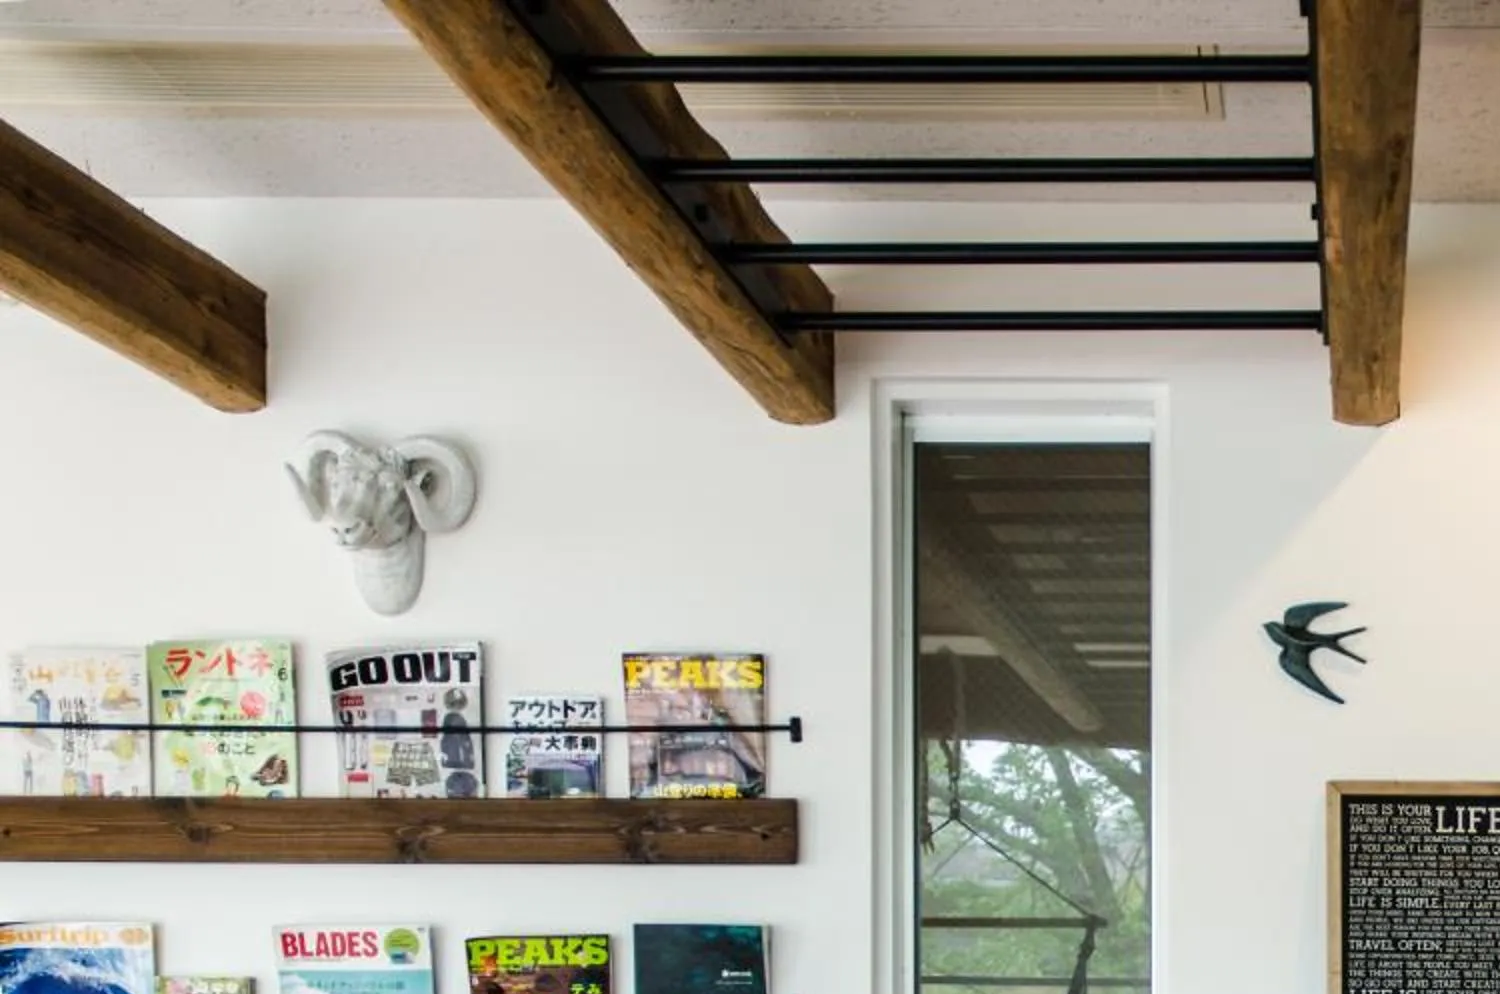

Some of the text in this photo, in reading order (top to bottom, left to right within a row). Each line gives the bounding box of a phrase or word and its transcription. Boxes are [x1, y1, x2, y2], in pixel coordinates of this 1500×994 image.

[331, 652, 477, 692] GO OUT
[624, 660, 763, 689] PEAKS
[508, 699, 597, 719] アウトドア
[1348, 804, 1378, 815] THIS
[1381, 804, 1393, 815] IS
[1397, 804, 1432, 816] YOUR
[1349, 896, 1377, 908] LIFE
[1380, 896, 1393, 908] IS
[280, 930, 379, 958] BLADES
[468, 936, 609, 969] PEAKS
[1348, 939, 1395, 951] TRAVEL
